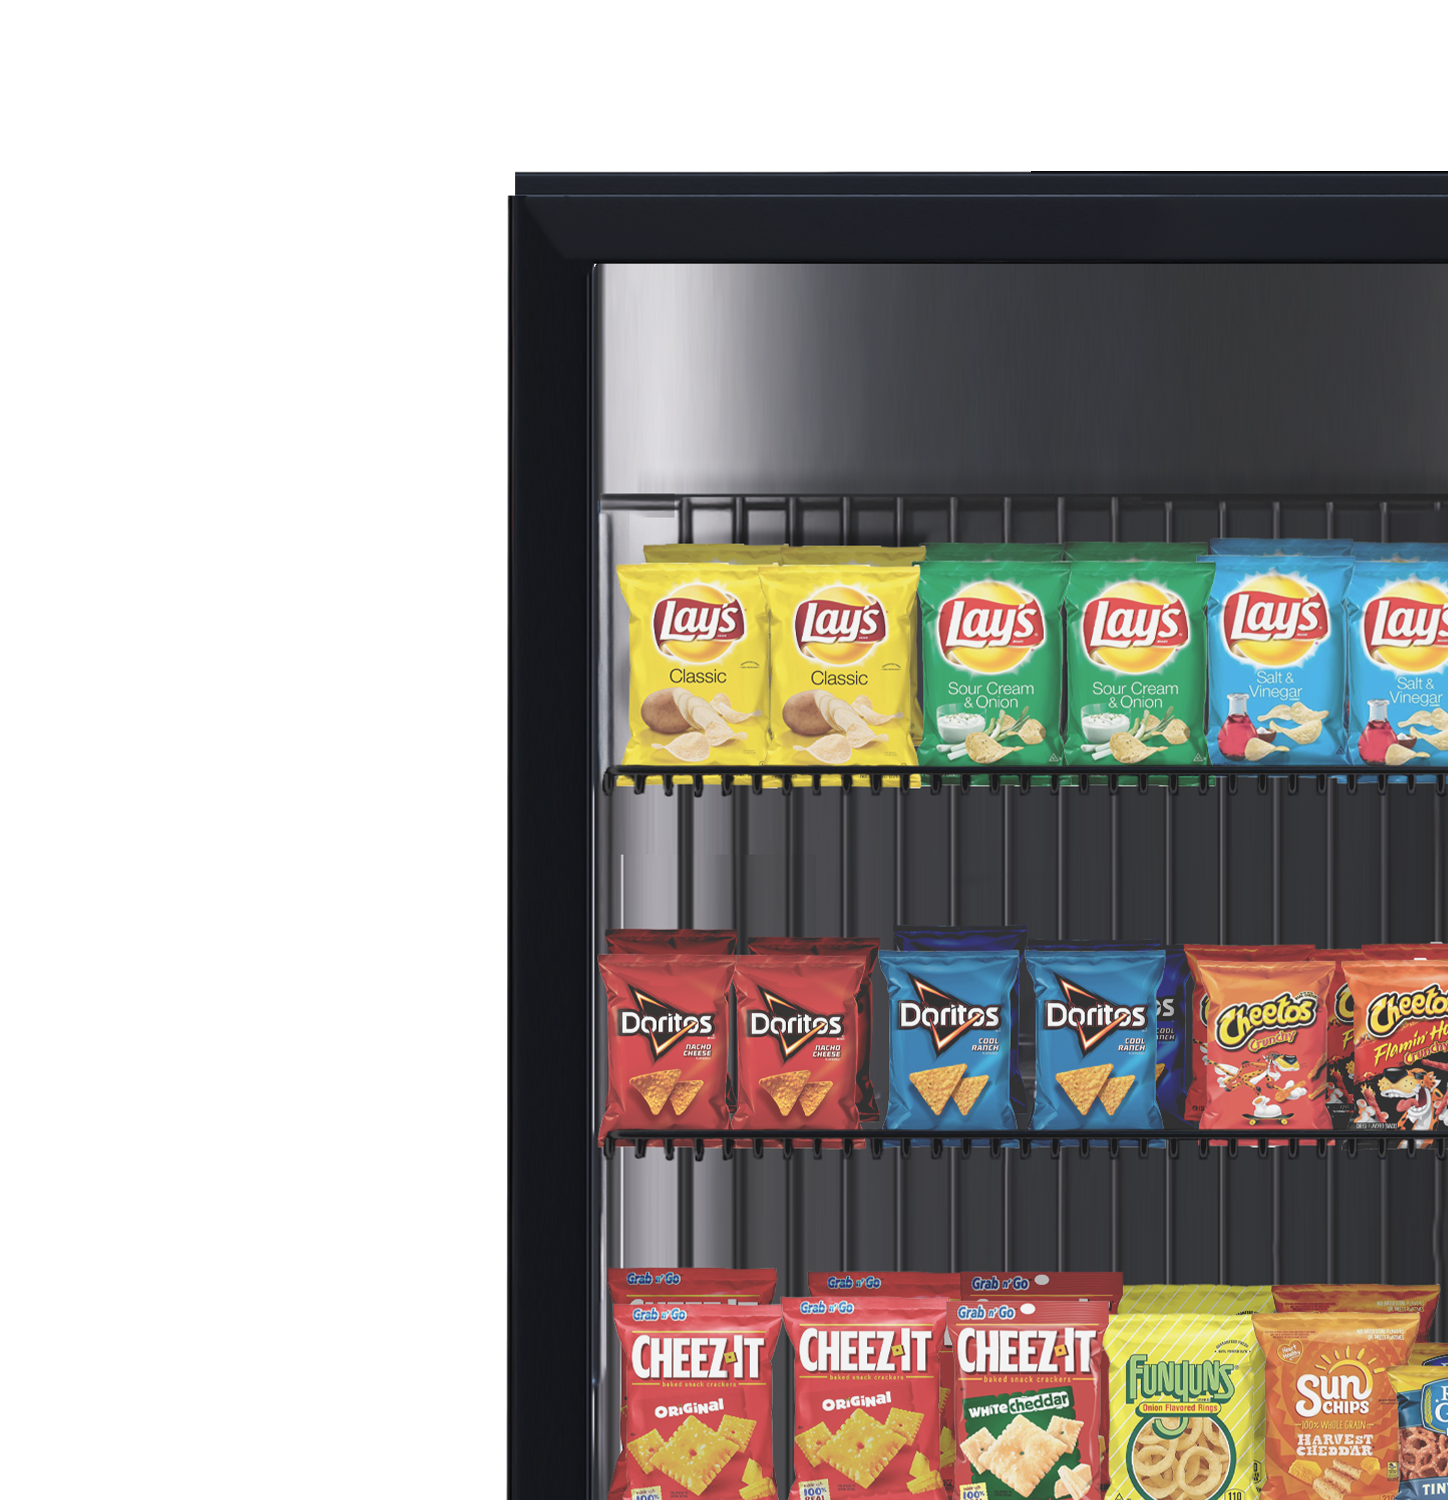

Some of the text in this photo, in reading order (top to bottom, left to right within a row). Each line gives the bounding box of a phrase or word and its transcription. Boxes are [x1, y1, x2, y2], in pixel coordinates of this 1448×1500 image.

[660, 601, 738, 642] Lay's
[949, 601, 1037, 647] Lay's
[1230, 595, 1321, 643] Lay's
[669, 669, 727, 685] Classic
[948, 682, 1035, 696] Sour Cream
[964, 696, 1018, 709] & Onion
[621, 1011, 713, 1036] Doritos
[900, 1002, 999, 1028] Doritos
[1216, 995, 1318, 1048] Cheetos
[1248, 1029, 1296, 1053] Crunchy
[1296, 1372, 1372, 1417] Sun
[1143, 1403, 1218, 1413] Onion Flavored Rings
[1322, 1401, 1369, 1415] CHIPS
[1297, 1434, 1373, 1446] HARVEST
[1297, 1445, 1374, 1457] CHEDDAR
